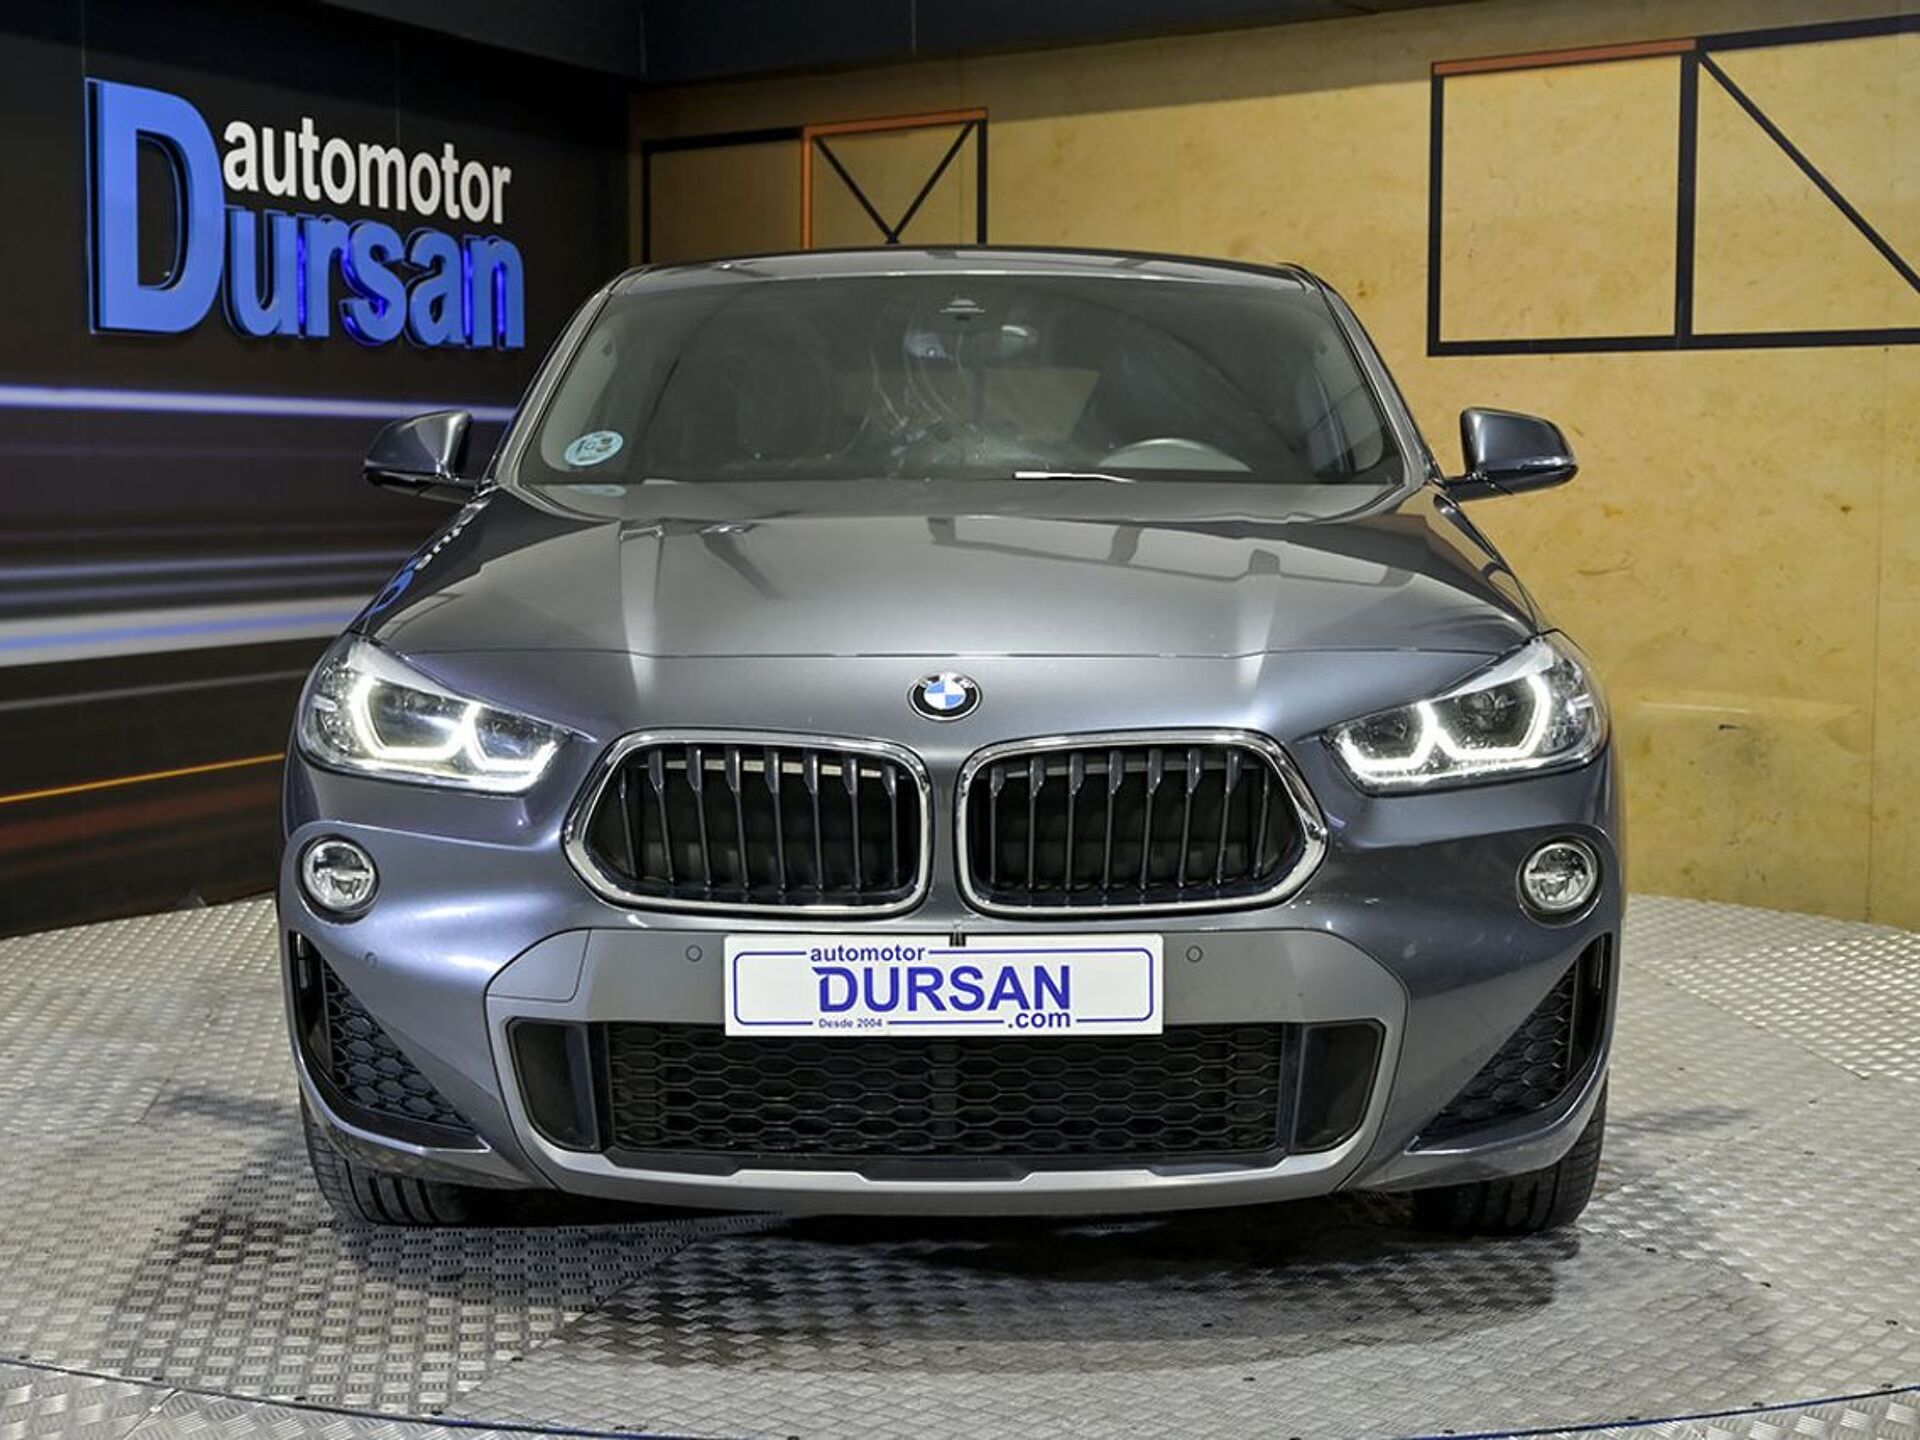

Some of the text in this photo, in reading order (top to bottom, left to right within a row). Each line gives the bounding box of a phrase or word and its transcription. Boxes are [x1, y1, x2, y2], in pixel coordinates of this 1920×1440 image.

[223, 117, 511, 224] automotor
[85, 77, 525, 349] Dursan
[811, 945, 925, 962] automotor
[812, 966, 1070, 1012] DURSAN
[818, 1018, 854, 1028] Desde
[1008, 1011, 1071, 1028] .com
